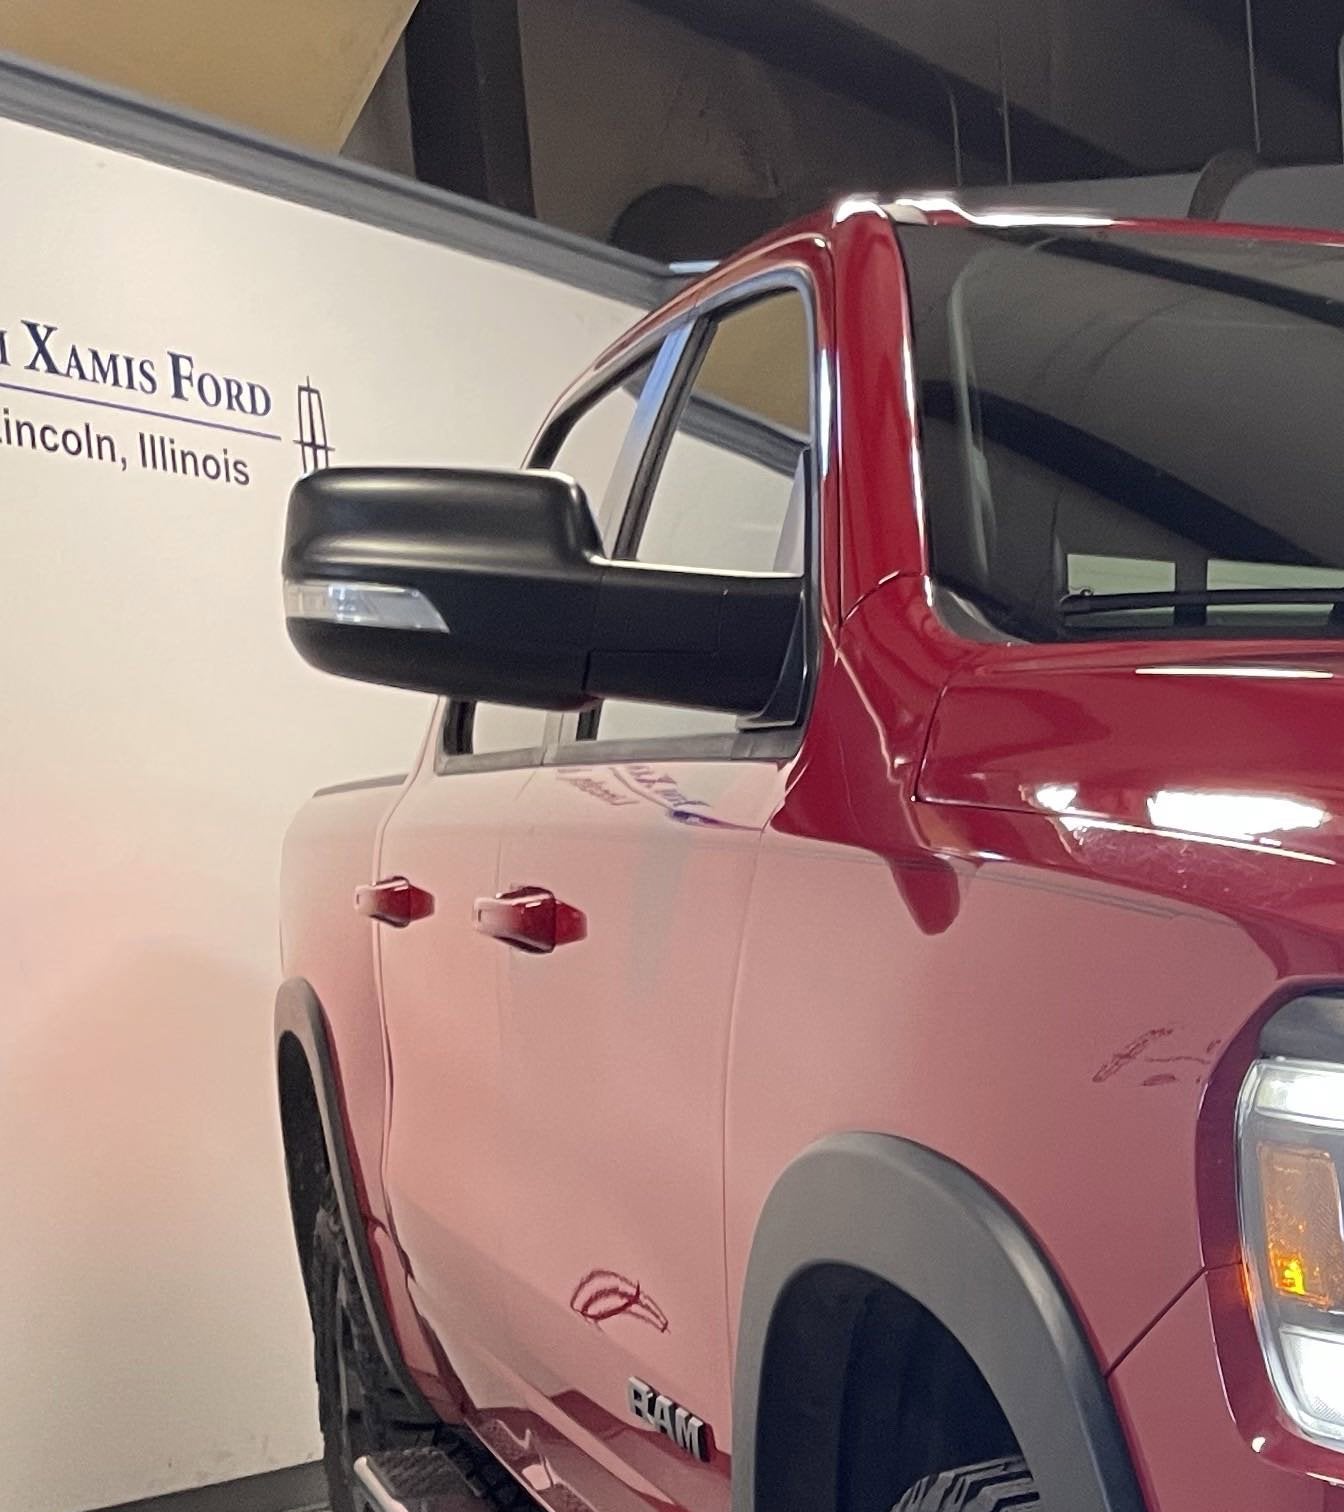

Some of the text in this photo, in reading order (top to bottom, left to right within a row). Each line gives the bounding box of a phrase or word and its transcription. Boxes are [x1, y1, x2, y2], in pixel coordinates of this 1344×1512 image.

[20, 319, 158, 394] XAMIS
[166, 351, 272, 417] FORD
[0, 406, 251, 486] incoln, Illinois
[627, 1375, 709, 1463] RAM
